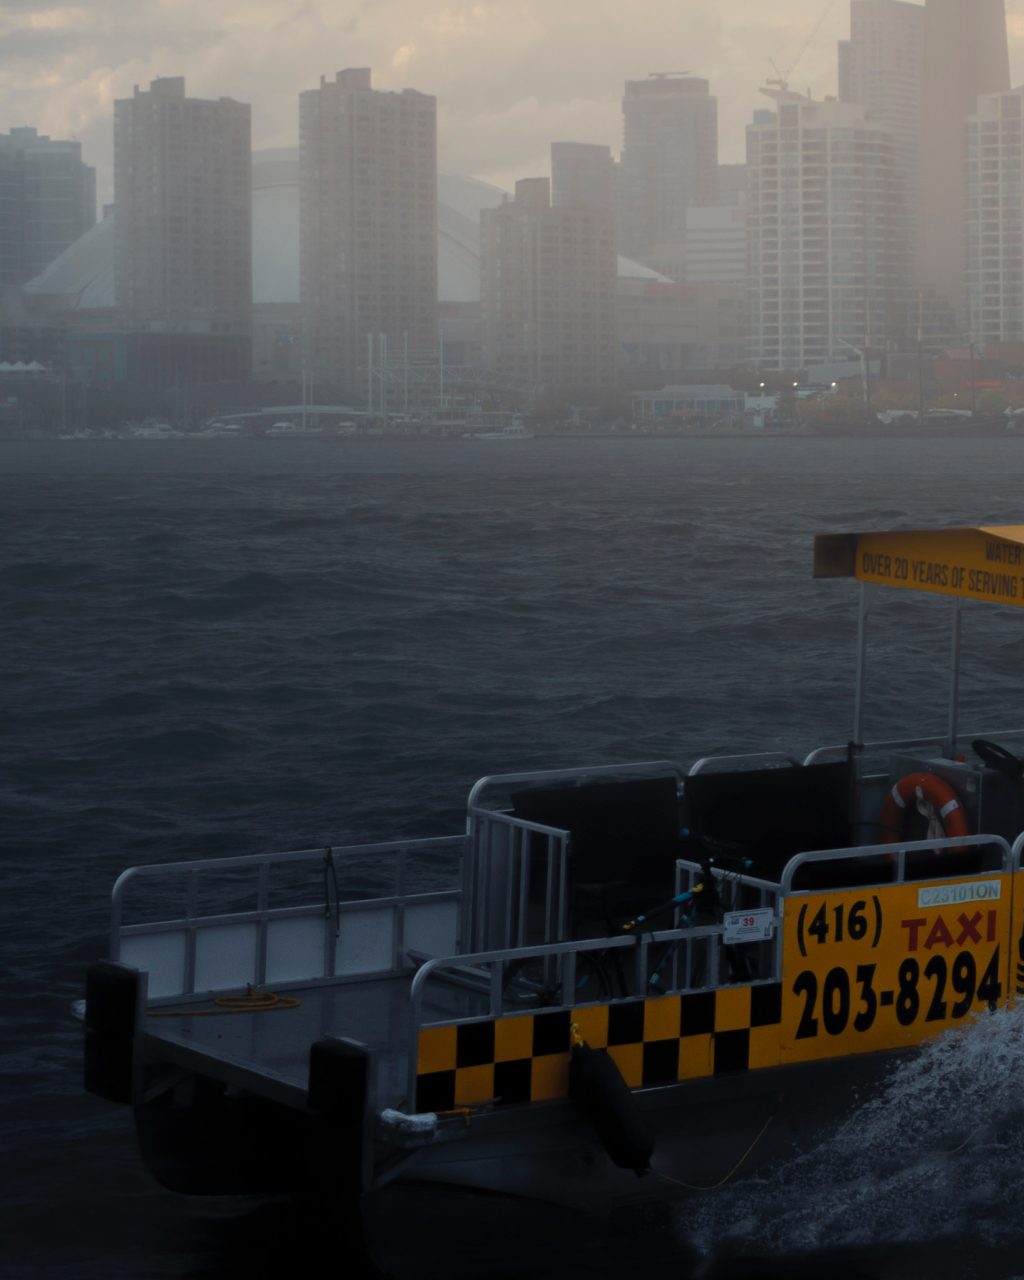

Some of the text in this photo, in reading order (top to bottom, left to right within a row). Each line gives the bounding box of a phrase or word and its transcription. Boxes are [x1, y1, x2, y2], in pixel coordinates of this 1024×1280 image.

[863, 552, 891, 577] OVER
[895, 557, 909, 580] 20
[912, 560, 948, 586] YEARS
[952, 566, 966, 588] OF
[968, 569, 1017, 598] SERVING
[986, 542, 1021, 564] WATER
[797, 896, 882, 957] (416)
[901, 910, 997, 951] TAXI
[793, 942, 1001, 1039] 203-8294
